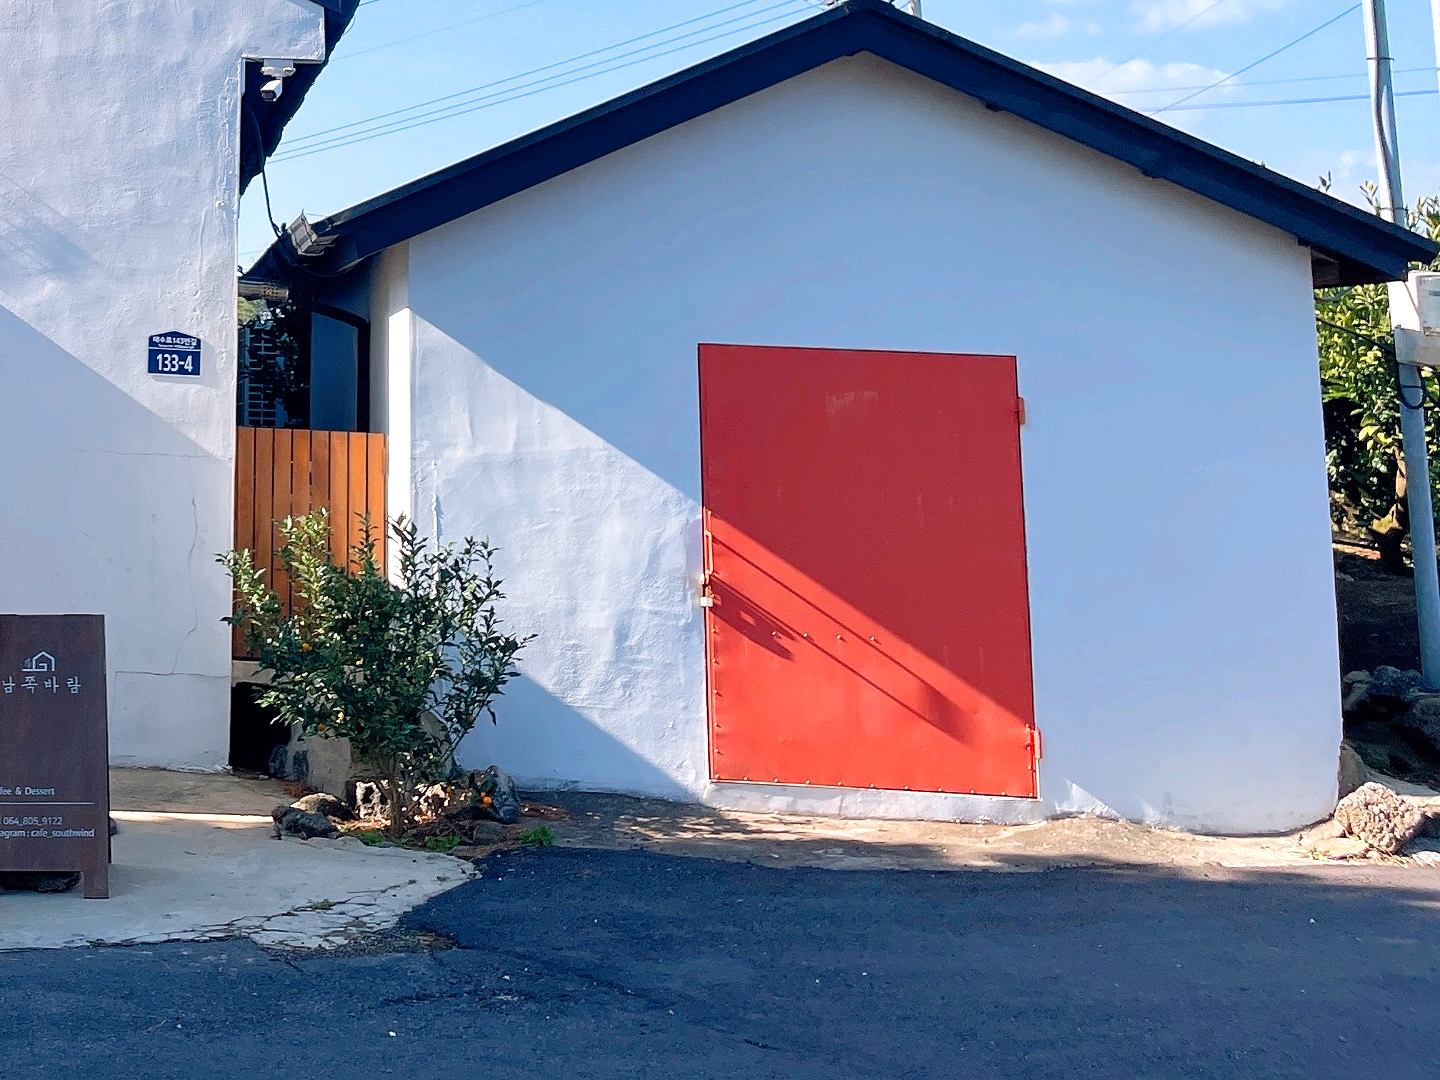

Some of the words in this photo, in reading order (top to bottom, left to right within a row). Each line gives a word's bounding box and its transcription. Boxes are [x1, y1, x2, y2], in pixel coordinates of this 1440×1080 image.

[156, 353, 193, 372] 133-4
[2, 675, 81, 694] 남쪽바람
[15, 786, 22, 796] &
[24, 786, 55, 796] Dessert
